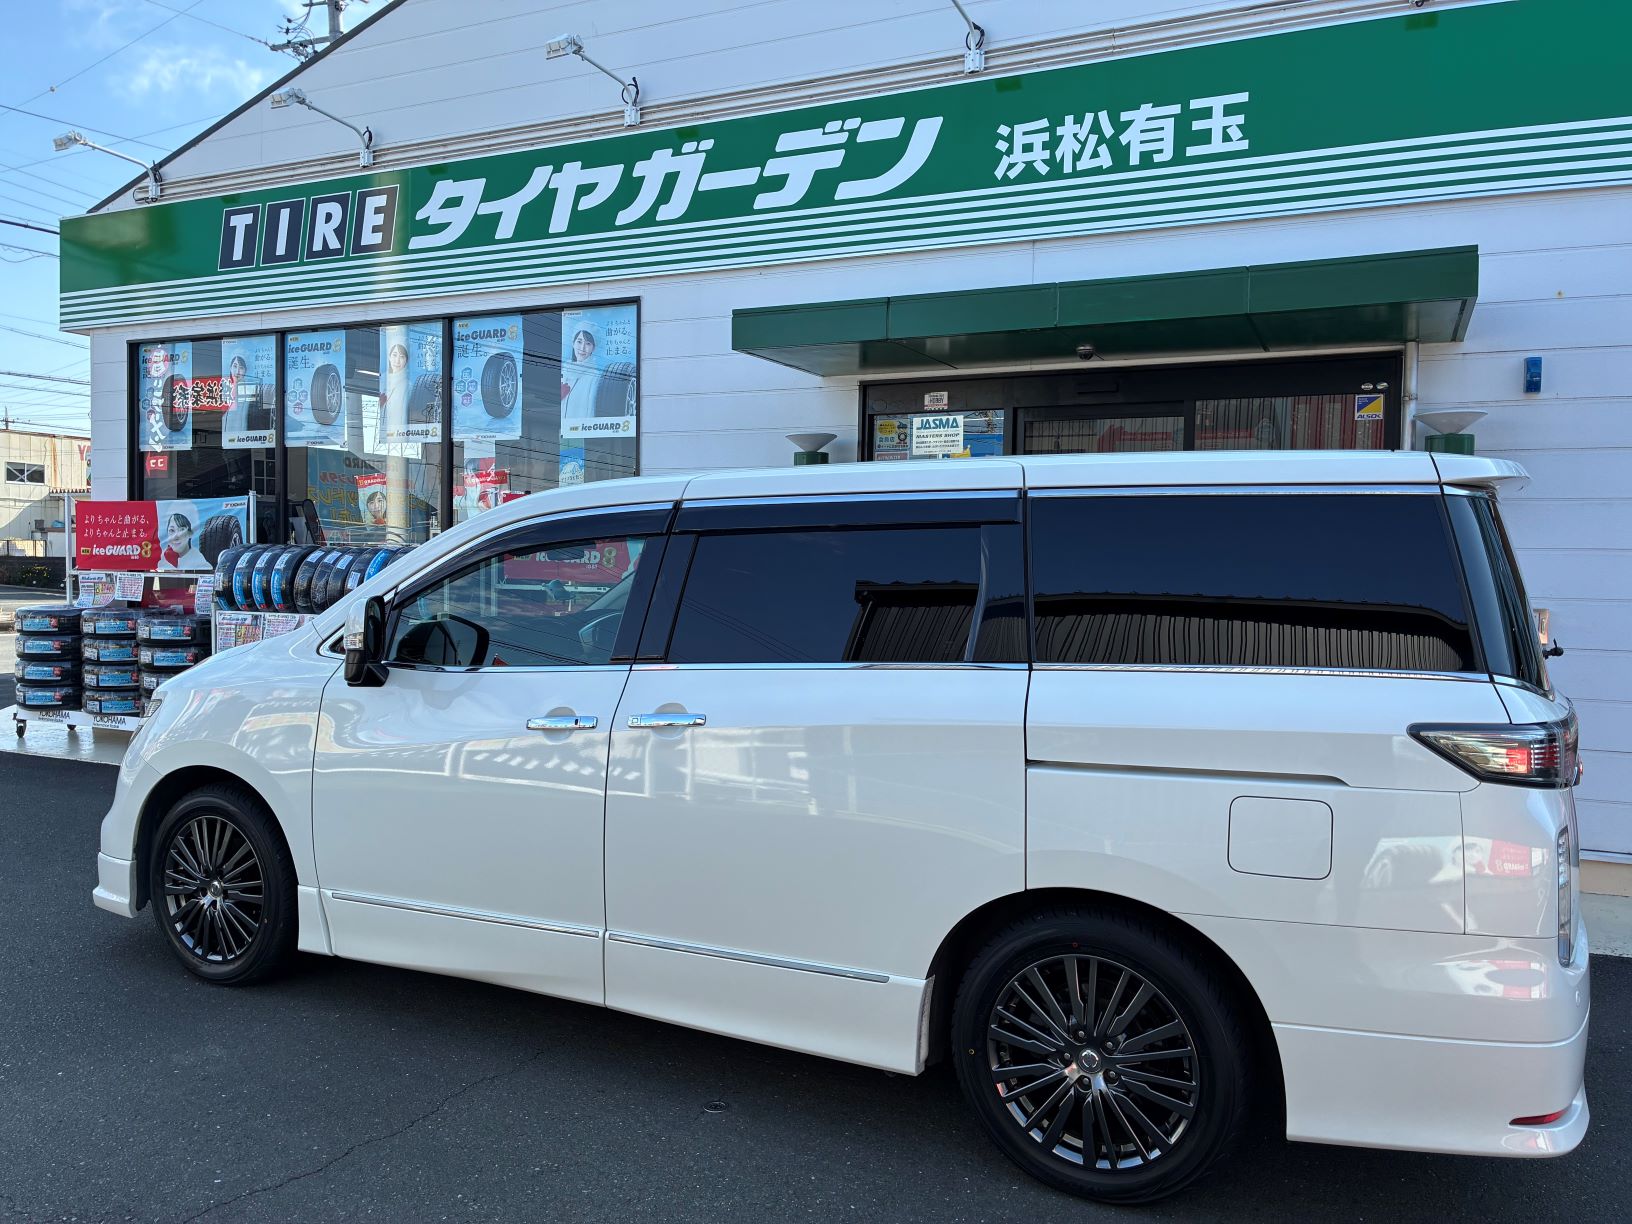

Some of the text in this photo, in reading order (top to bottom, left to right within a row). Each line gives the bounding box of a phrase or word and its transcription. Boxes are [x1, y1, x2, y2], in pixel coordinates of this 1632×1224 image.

[994, 91, 1250, 180] 浜松有玉
[408, 116, 944, 250] タイヤガーデン
[229, 194, 388, 261] TIRE
[457, 329, 507, 342] iceGUARD
[288, 343, 332, 354] iceGUARD
[581, 423, 621, 431] iceGUARD
[916, 417, 960, 430] JASMA
[236, 435, 267, 443] iceGUARD
[396, 429, 430, 437] iceGUARD
[92, 544, 140, 556] iceGUARD
[93, 715, 127, 726] YOKOHAMA
